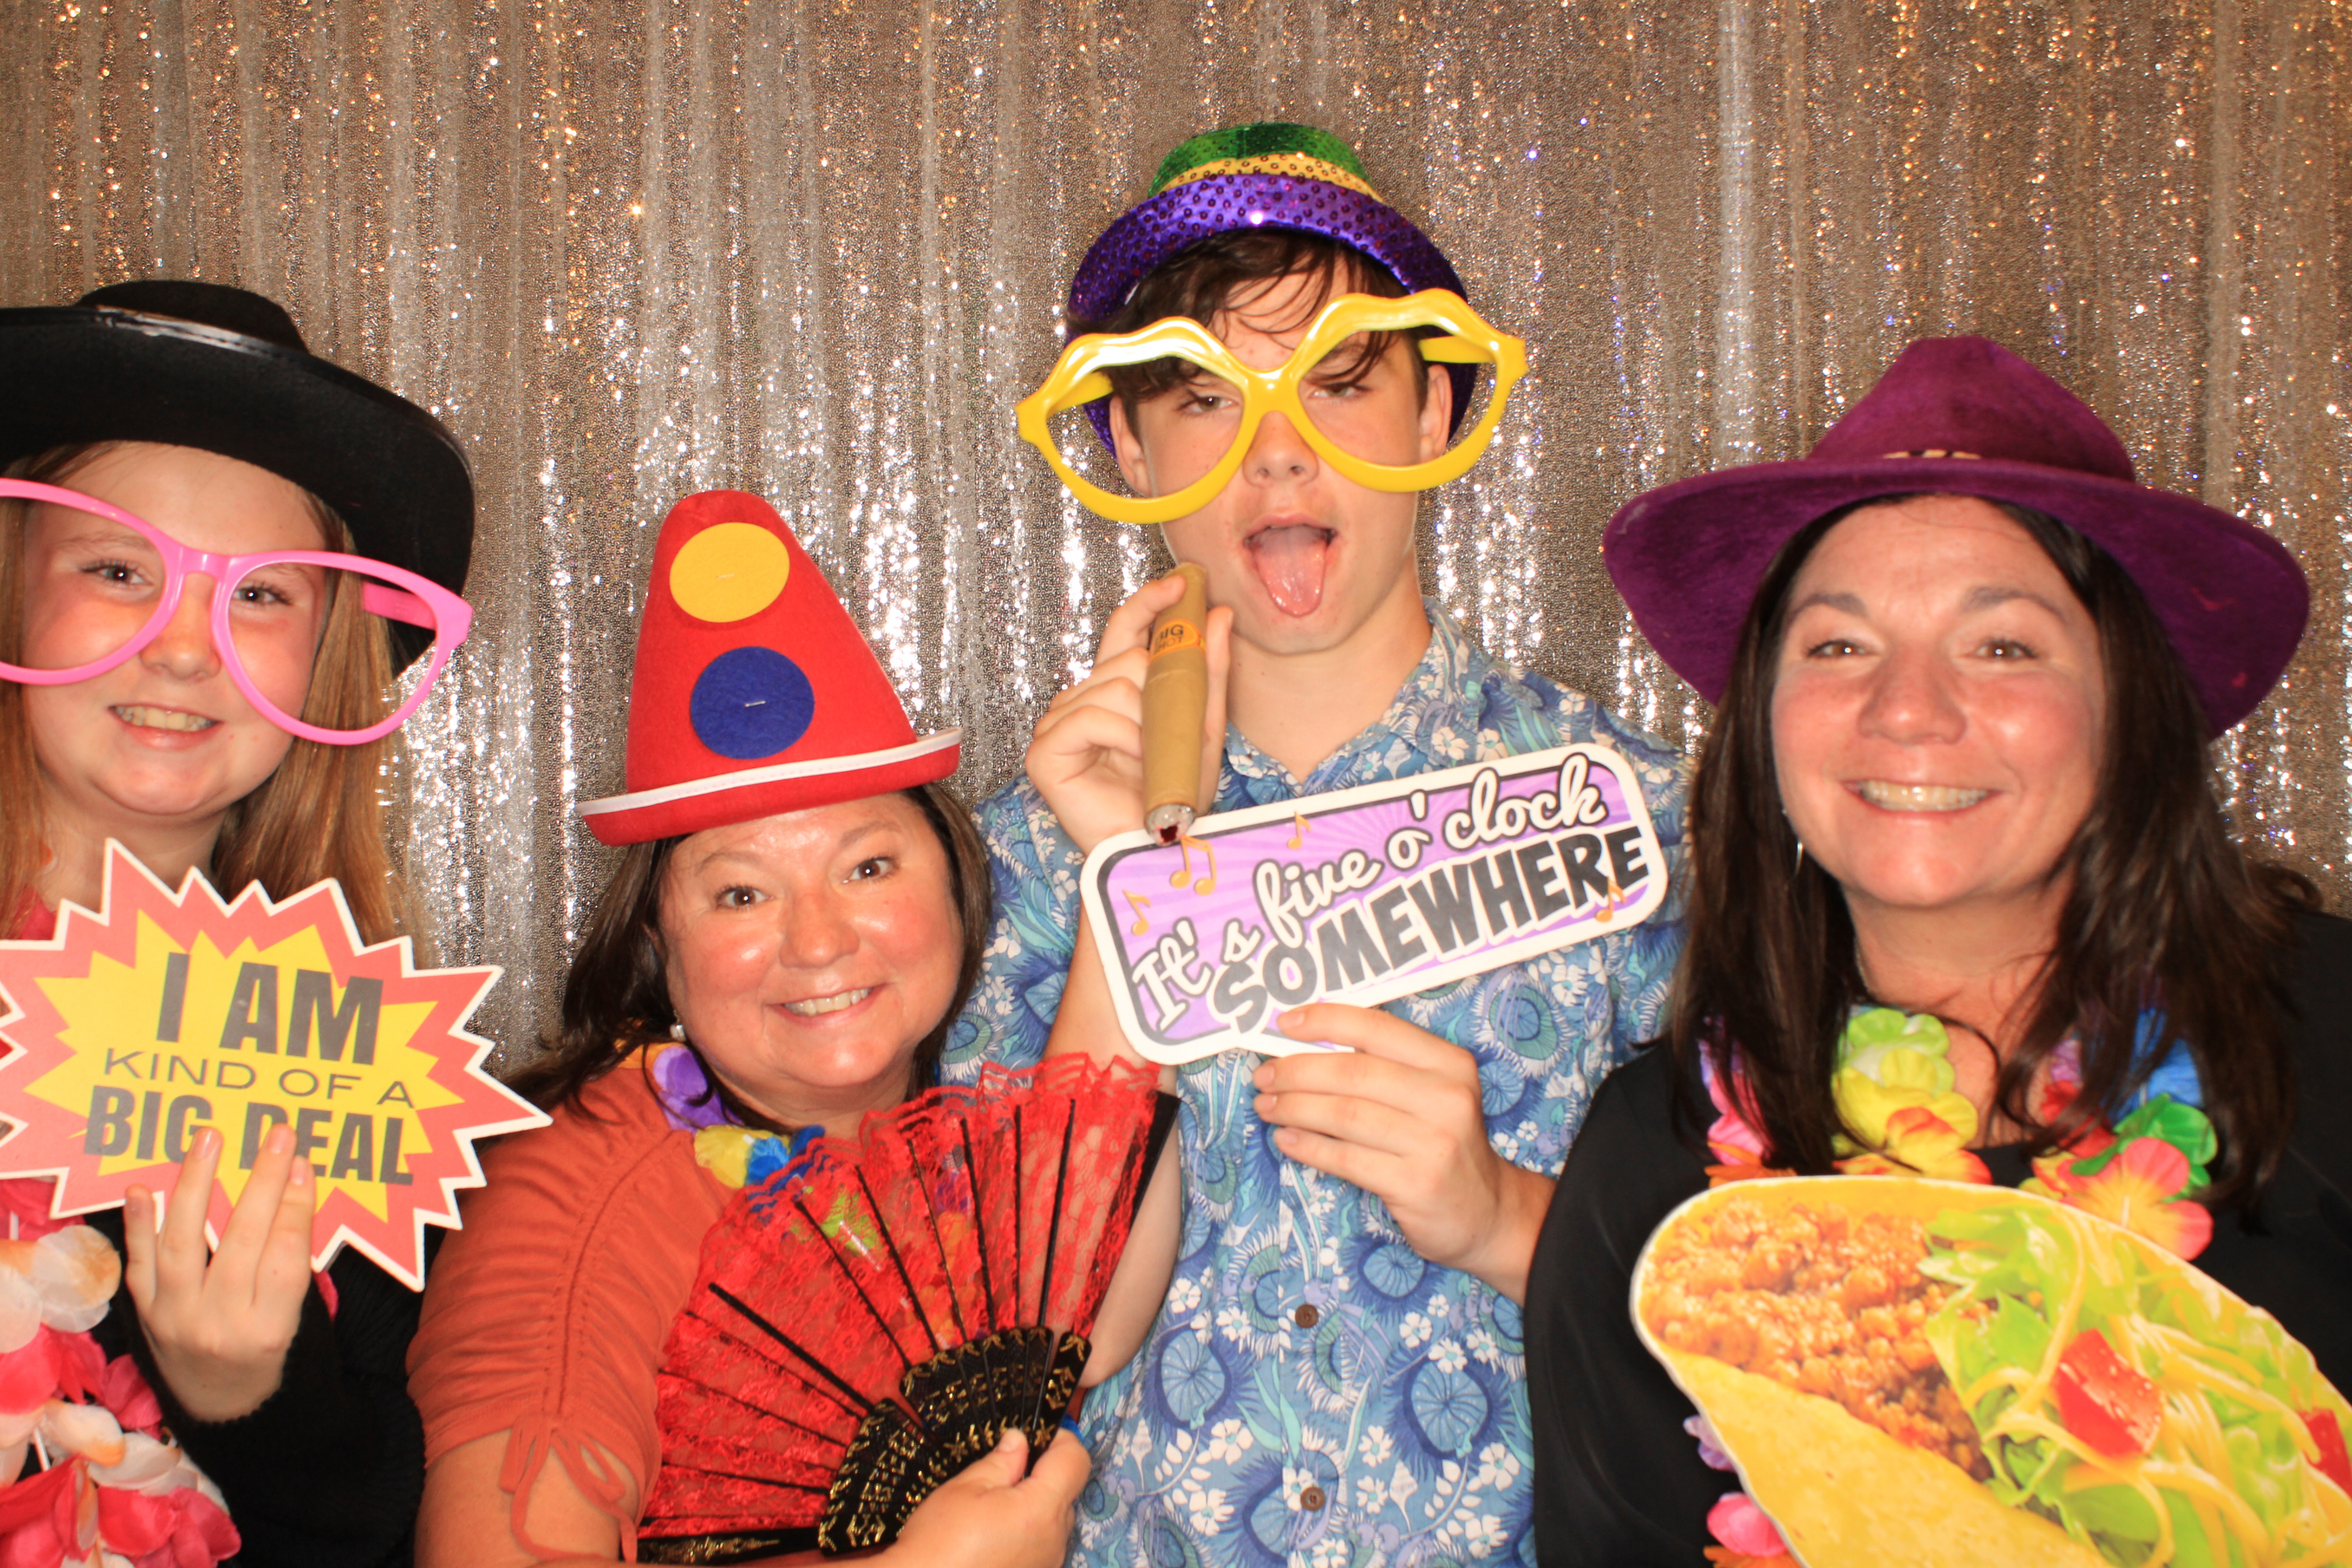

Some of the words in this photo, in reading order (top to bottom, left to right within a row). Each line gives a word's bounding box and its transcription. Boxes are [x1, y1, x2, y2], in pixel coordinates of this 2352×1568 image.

[1130, 917, 1263, 1032] It's
[1255, 851, 1383, 948] five
[1214, 826, 1648, 1033] SOMEWHERE
[157, 952, 190, 1043] I
[219, 962, 384, 1065] AM
[104, 1048, 255, 1089] KIND
[279, 1069, 361, 1100] OF
[377, 1082, 414, 1108] A
[84, 1085, 213, 1164] BIG
[239, 1102, 413, 1185] DEAL
